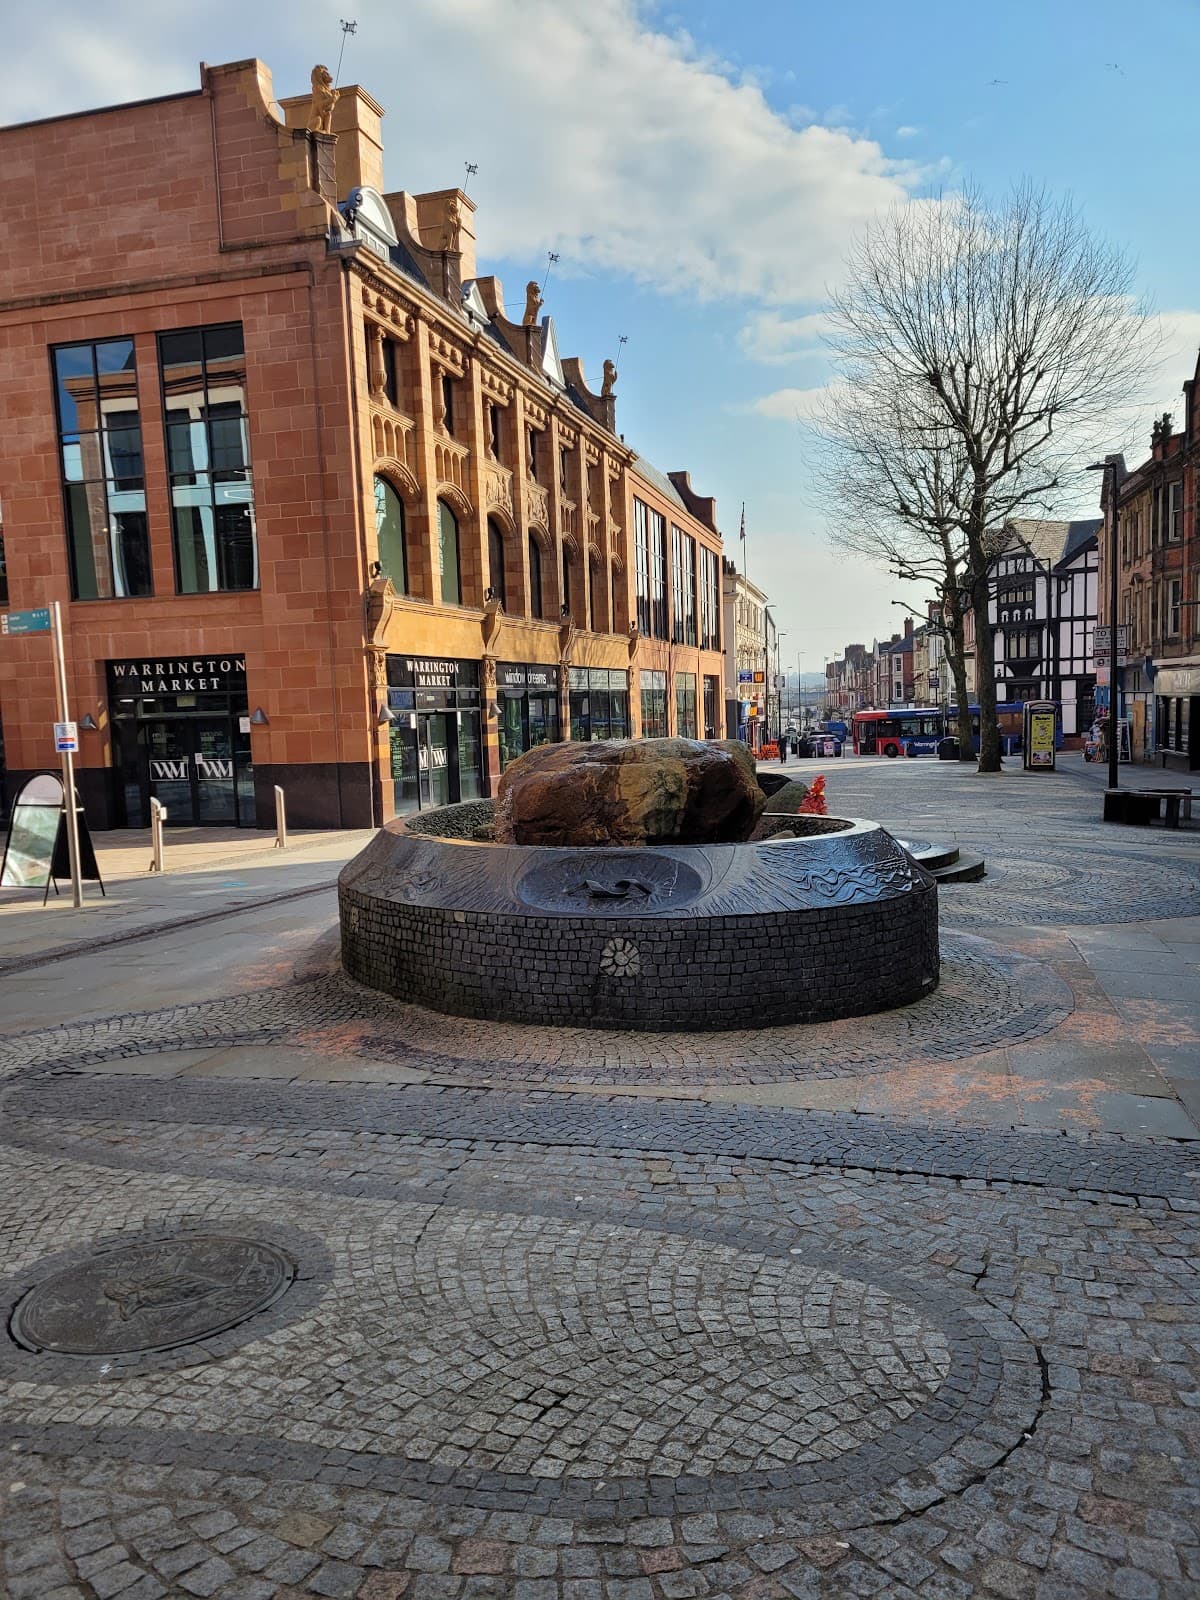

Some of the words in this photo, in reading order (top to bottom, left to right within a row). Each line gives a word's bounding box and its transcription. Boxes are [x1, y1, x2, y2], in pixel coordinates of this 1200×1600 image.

[113, 660, 246, 676] WARRINGTON
[406, 660, 459, 673] WARRINGTON
[419, 675, 451, 686] MARKET
[504, 667, 526, 684] window
[527, 668, 547, 684] dreams
[141, 678, 220, 692] MARKET
[151, 761, 187, 778] WM
